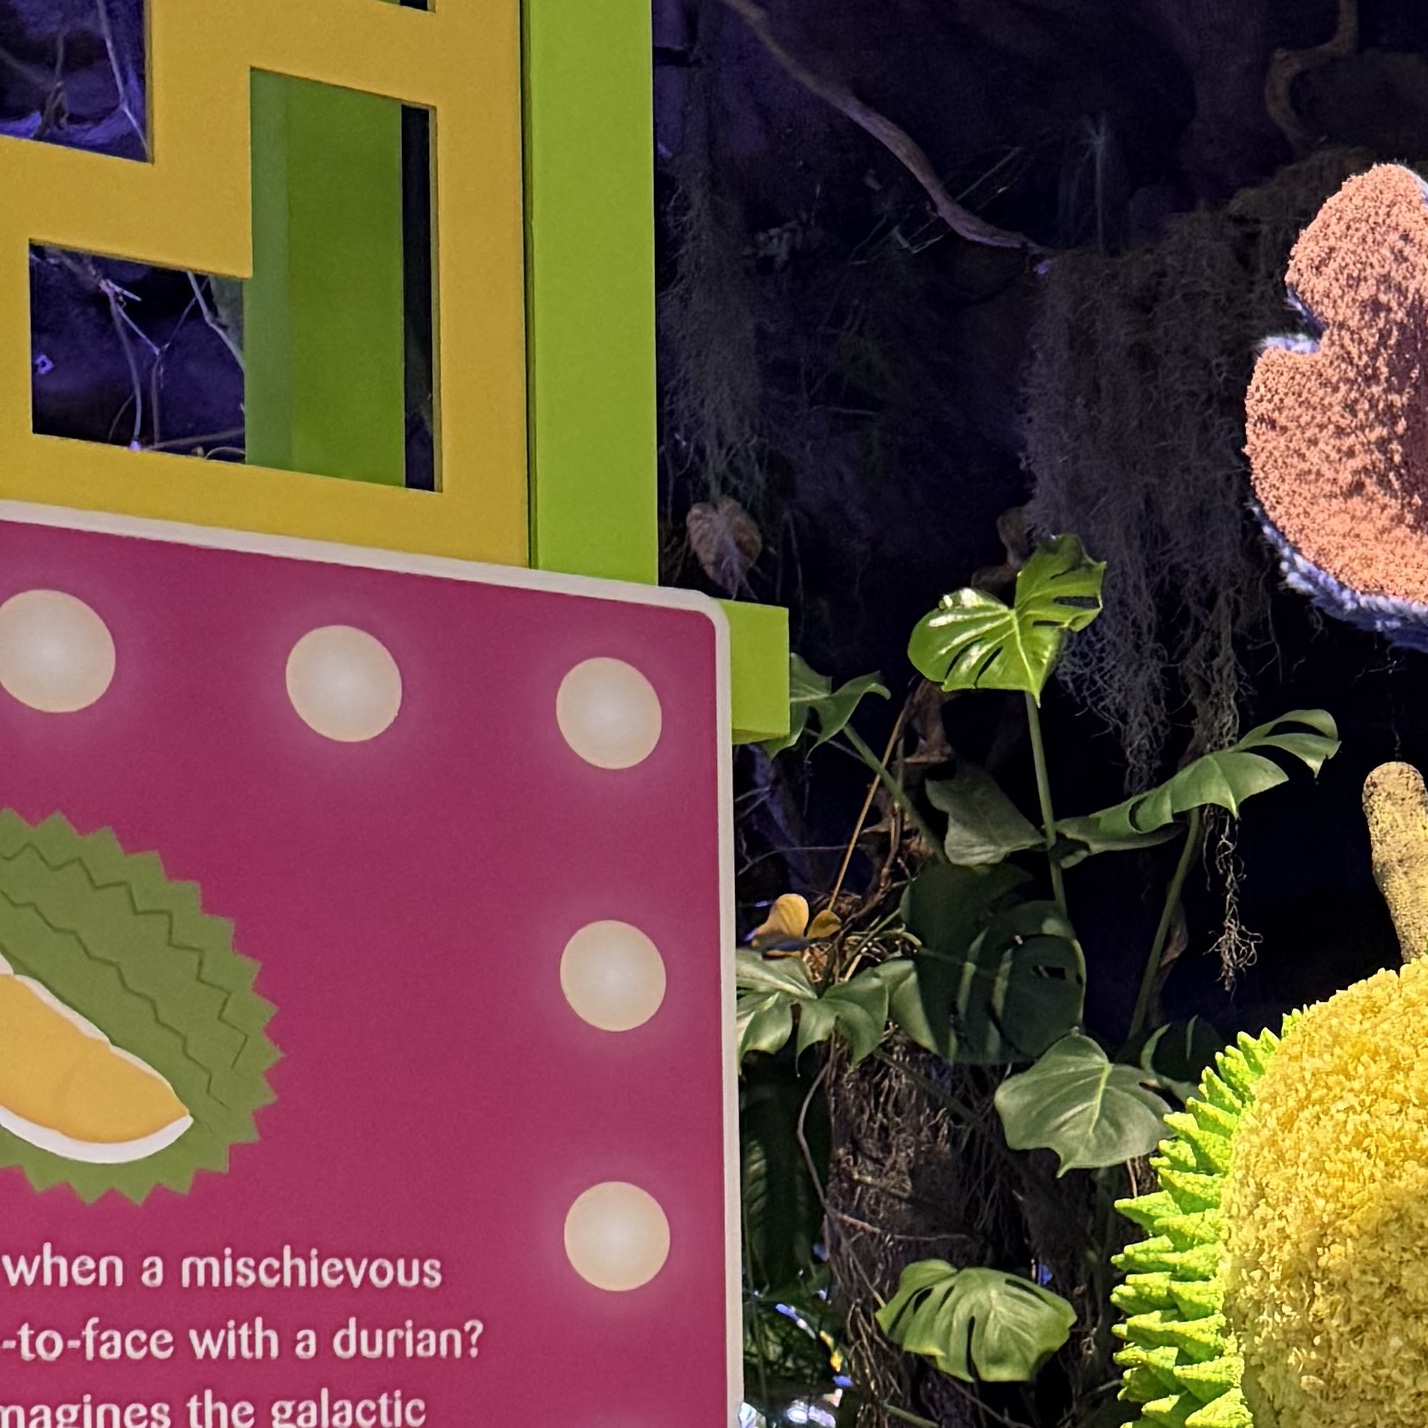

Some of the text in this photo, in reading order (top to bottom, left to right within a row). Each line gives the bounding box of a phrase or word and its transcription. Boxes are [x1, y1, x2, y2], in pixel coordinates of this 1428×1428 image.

[1, 1241, 443, 1290] when a mischievous
[188, 1316, 279, 1360] with
[294, 1329, 317, 1360] a
[332, 1315, 485, 1359] durian?
